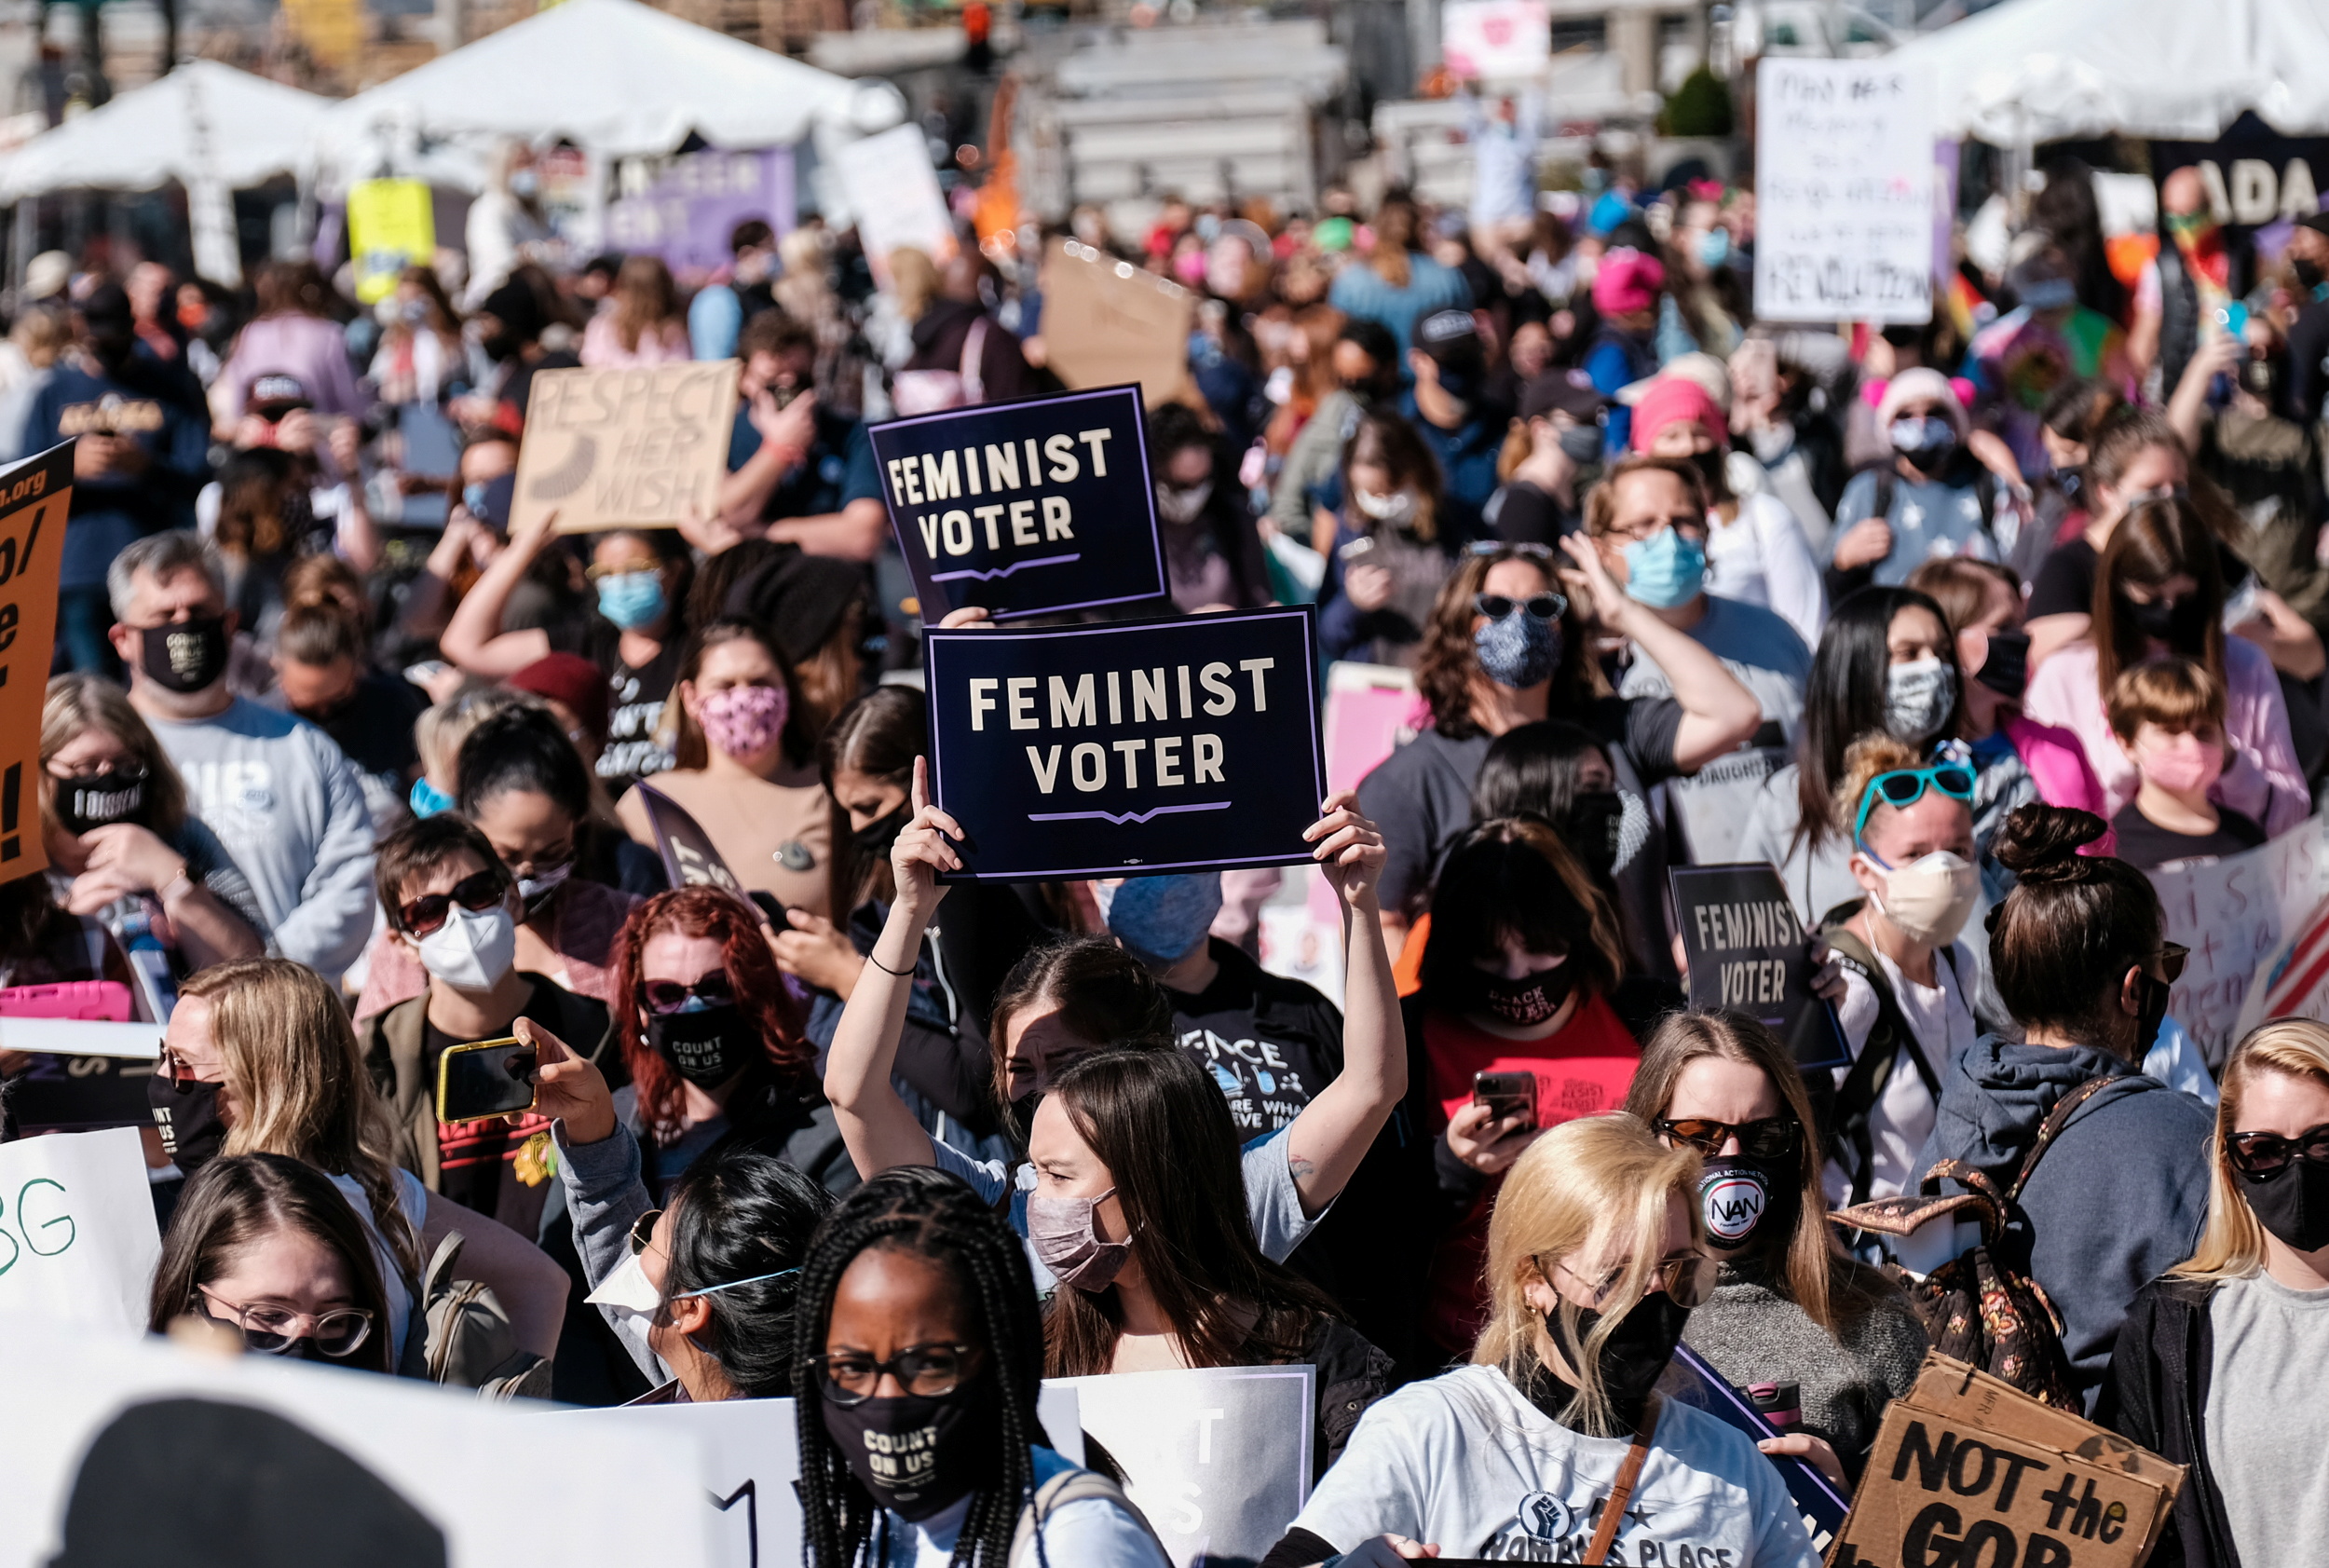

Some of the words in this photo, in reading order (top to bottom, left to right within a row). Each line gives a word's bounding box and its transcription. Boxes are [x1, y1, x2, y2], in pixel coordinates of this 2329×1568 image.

[527, 371, 733, 432] RESPECT
[613, 425, 706, 470] HER
[888, 427, 1112, 508] FEMINIST
[594, 469, 706, 515] WISH
[918, 496, 1075, 560] VOTER
[969, 657, 1275, 731] FEMINIST
[1026, 733, 1226, 794] VOTER
[1694, 900, 1803, 952] FEMINIST
[1720, 959, 1787, 1007] VOTER
[673, 1036, 722, 1054] COUNT
[678, 1055, 697, 1067] ON
[702, 1052, 722, 1066] US
[1697, 1170, 1723, 1193] NATIONAL
[1723, 1168, 1749, 1177] ACTION
[1711, 1193, 1759, 1221] NAN
[1976, 1387, 2001, 1417] MFR
[863, 1426, 937, 1454] COUNT
[869, 1452, 897, 1476] ON
[905, 1451, 935, 1474] US
[1890, 1420, 2050, 1513] NOT
[2041, 1472, 2128, 1544] the
